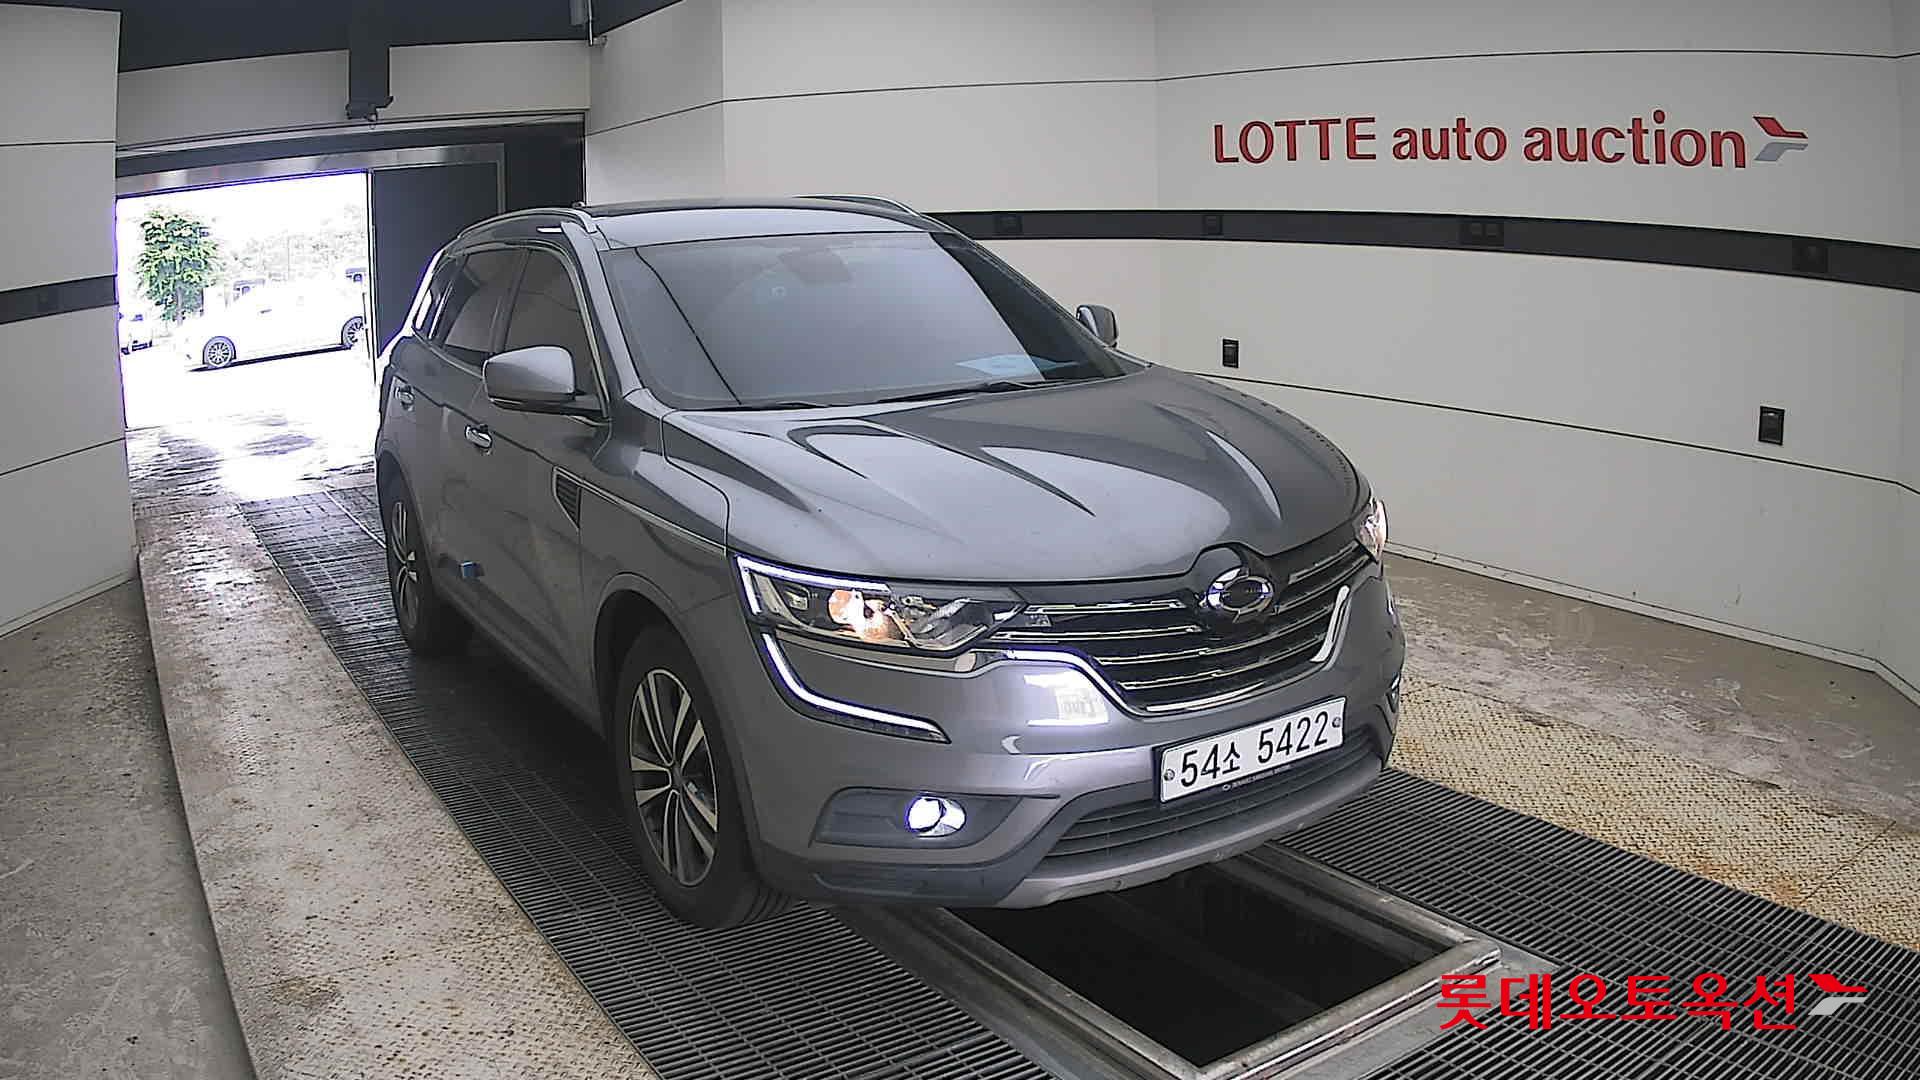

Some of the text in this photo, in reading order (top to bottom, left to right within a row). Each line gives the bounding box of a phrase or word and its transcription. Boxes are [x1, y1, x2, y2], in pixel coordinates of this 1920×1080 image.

[1214, 109, 1747, 169] LOTTE auto auction
[1180, 741, 1241, 787] 54소
[1257, 711, 1329, 764] 5422
